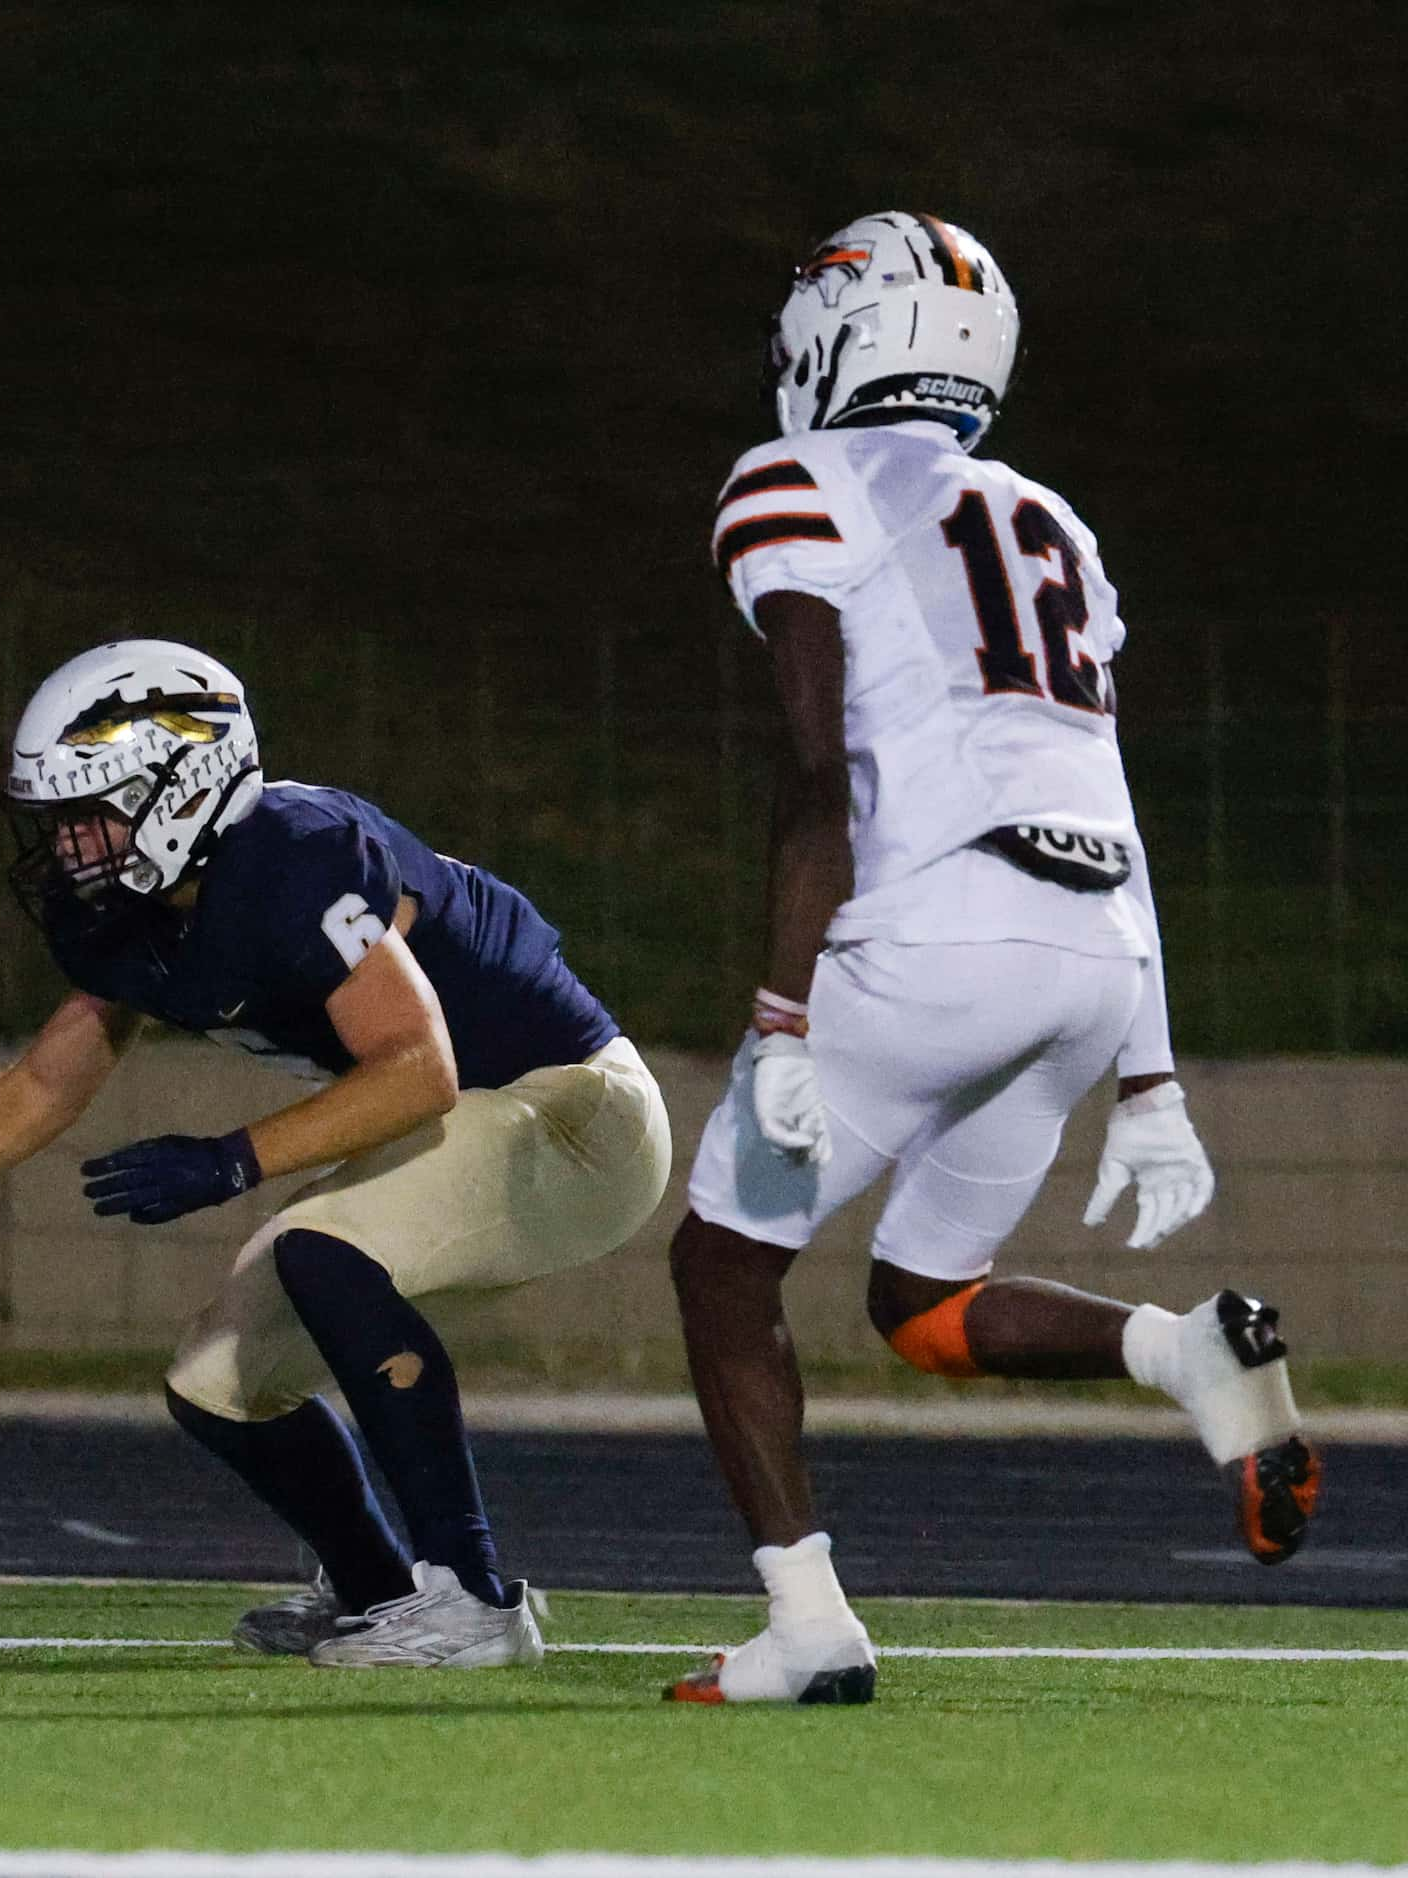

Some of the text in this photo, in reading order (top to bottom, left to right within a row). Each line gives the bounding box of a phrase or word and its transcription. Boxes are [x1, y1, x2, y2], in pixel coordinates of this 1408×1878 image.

[913, 375, 985, 404] schutt
[940, 489, 1105, 717] 12
[320, 893, 386, 972] 6
